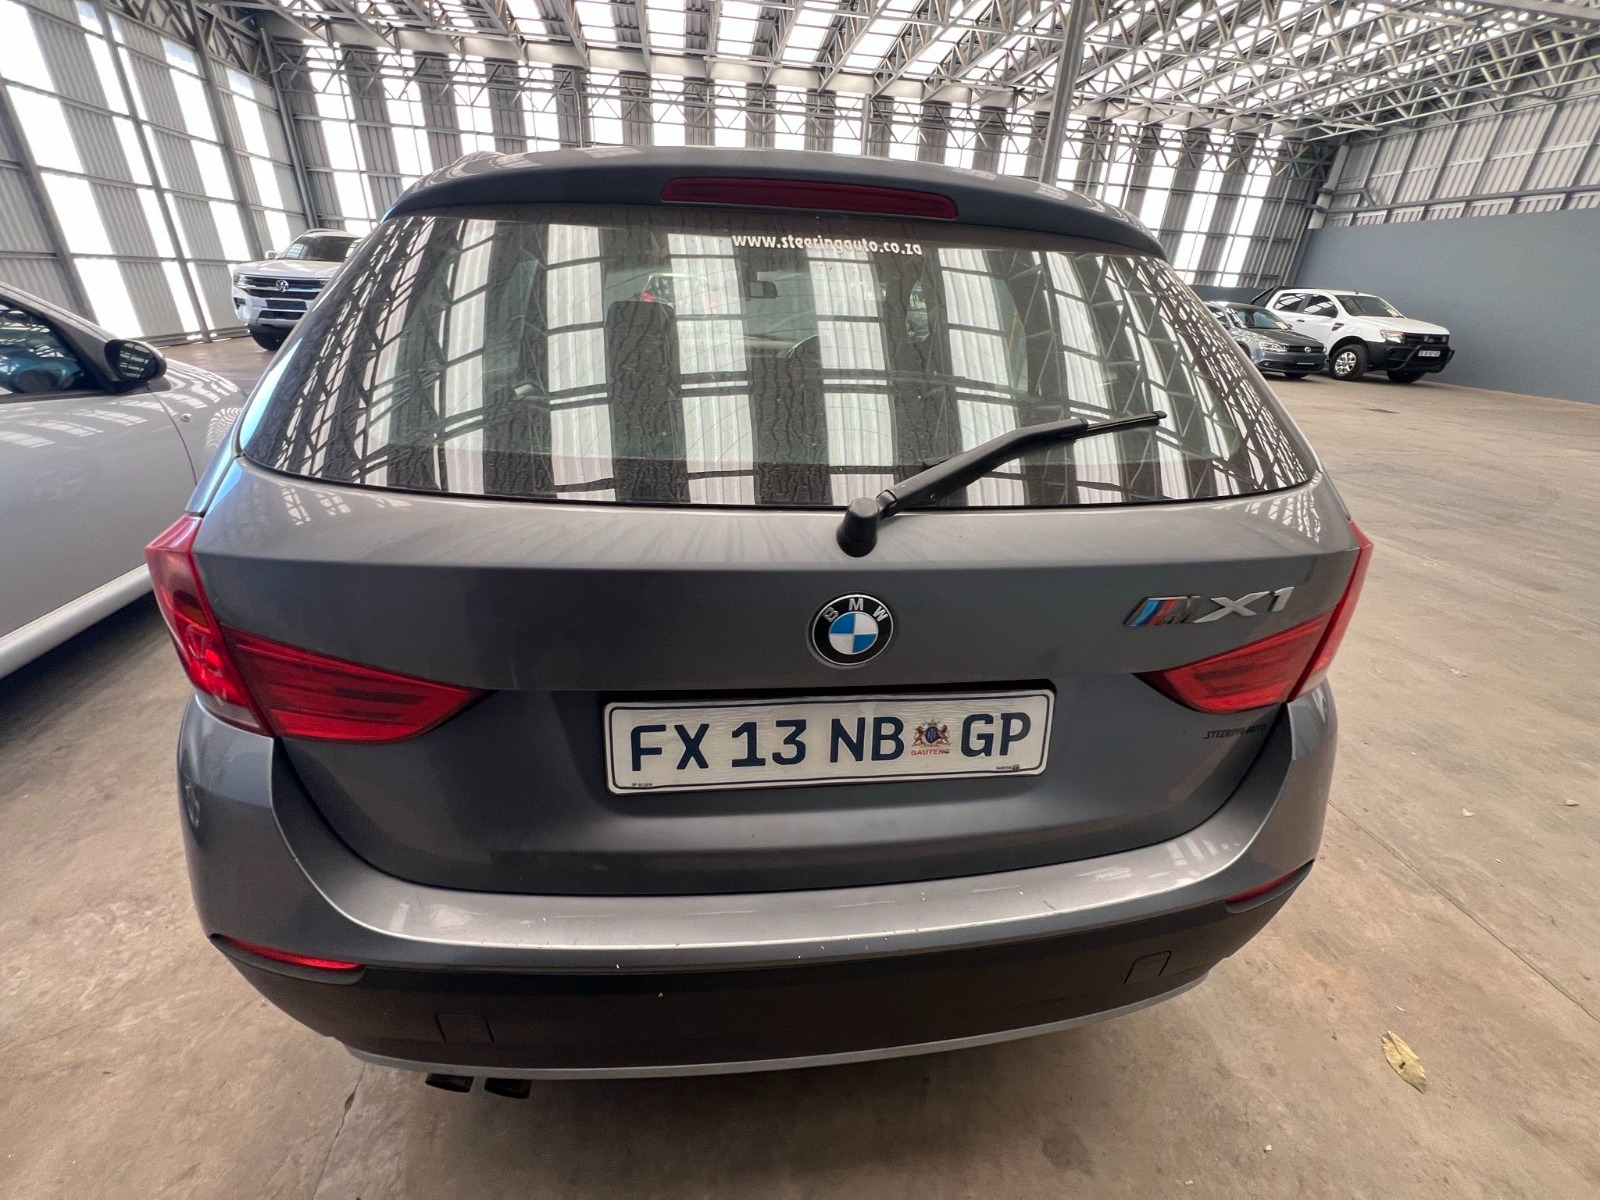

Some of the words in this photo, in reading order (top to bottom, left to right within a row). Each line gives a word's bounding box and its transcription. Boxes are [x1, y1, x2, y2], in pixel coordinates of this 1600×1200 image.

[732, 235, 923, 256] www.steeringauto.co.za
[821, 597, 889, 623] BMW
[1191, 586, 1294, 624] X1
[629, 723, 710, 772] FX
[731, 718, 807, 767] 13
[829, 716, 905, 762] NB
[960, 711, 1031, 757] GP
[910, 748, 950, 756] GAUTENG
